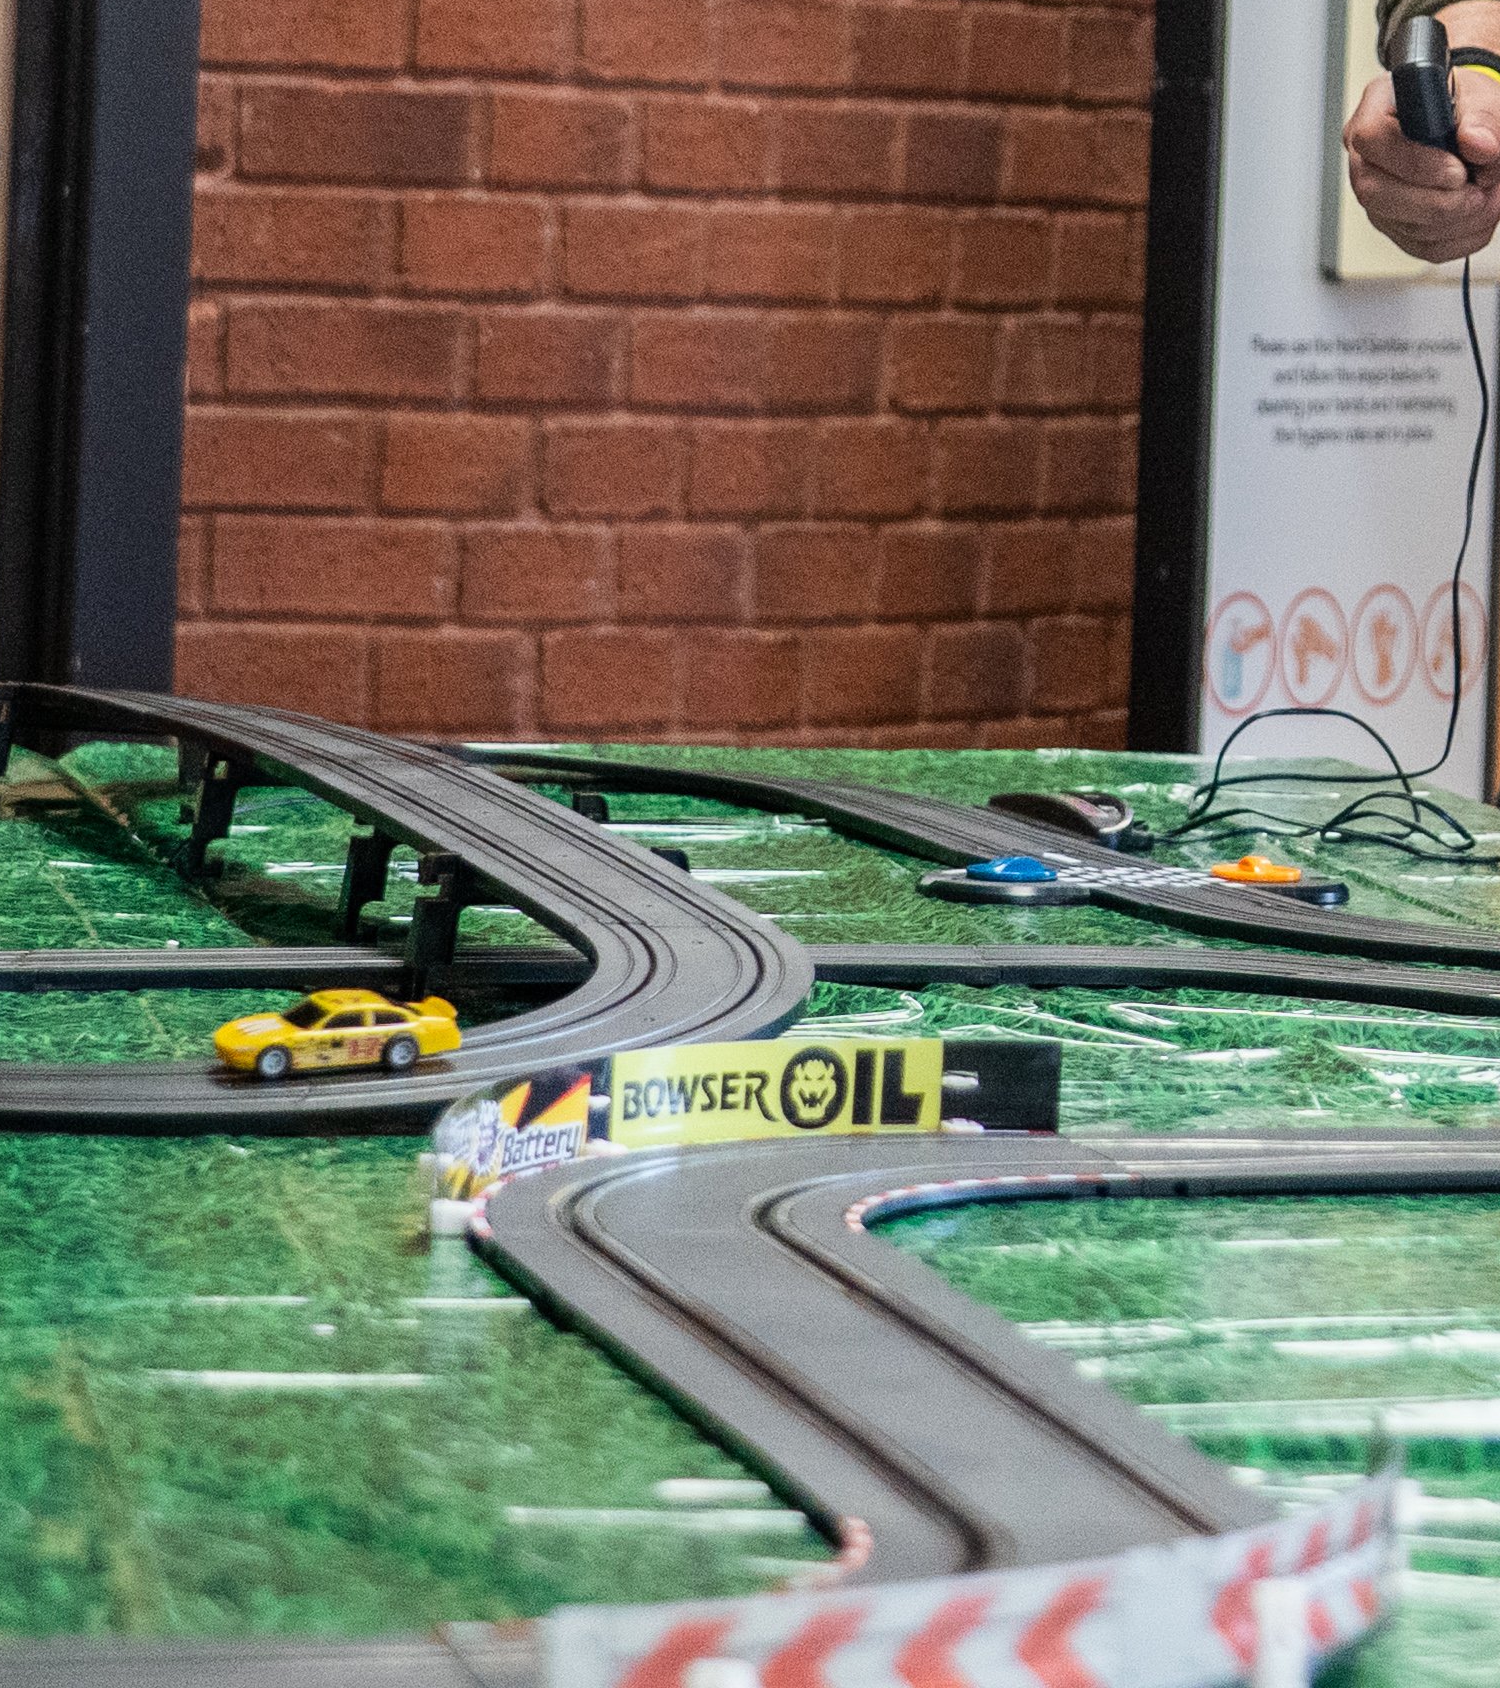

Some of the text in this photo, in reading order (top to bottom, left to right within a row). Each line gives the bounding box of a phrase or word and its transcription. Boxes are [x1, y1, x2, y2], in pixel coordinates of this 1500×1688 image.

[622, 1046, 926, 1129] BOWSER OIL
[501, 1125, 581, 1168] Battery
